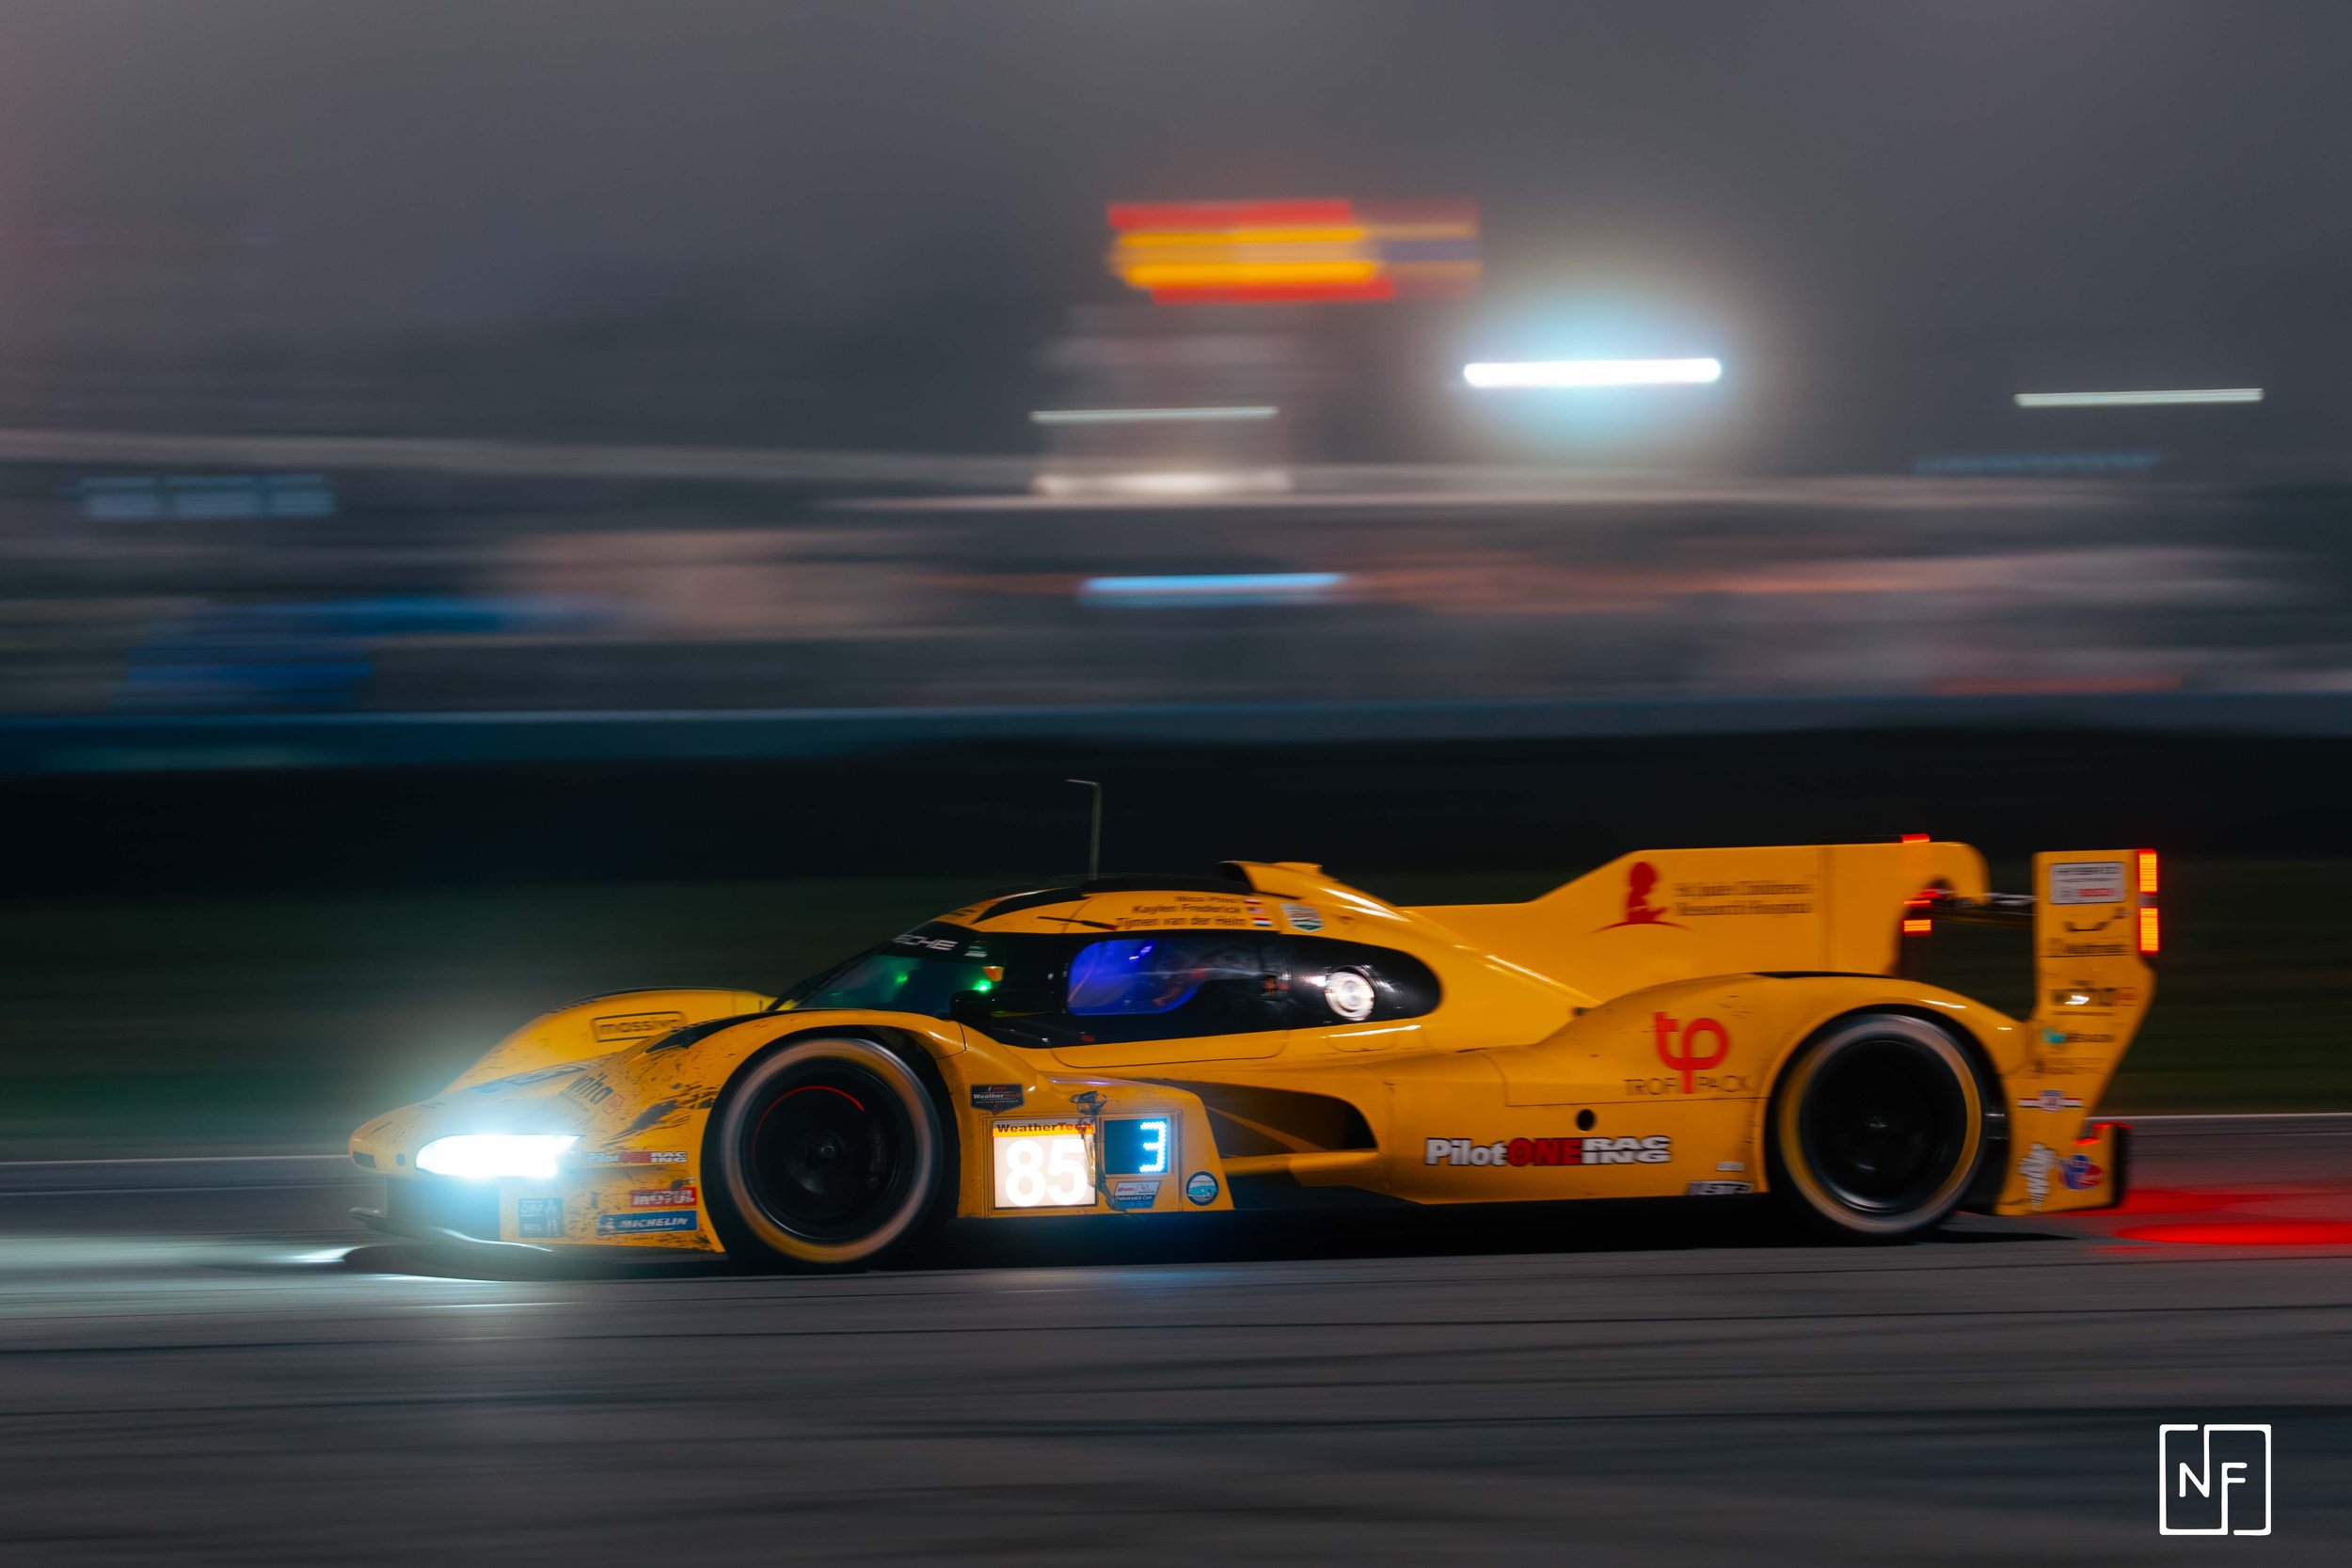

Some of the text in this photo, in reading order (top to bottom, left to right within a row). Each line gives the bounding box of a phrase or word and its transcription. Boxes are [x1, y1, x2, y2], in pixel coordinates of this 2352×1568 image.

[1190, 916, 1212, 926] der
[1139, 1120, 1168, 1173] 3
[1005, 1138, 1089, 1208] 85
[620, 1217, 688, 1228] MICHELIN
